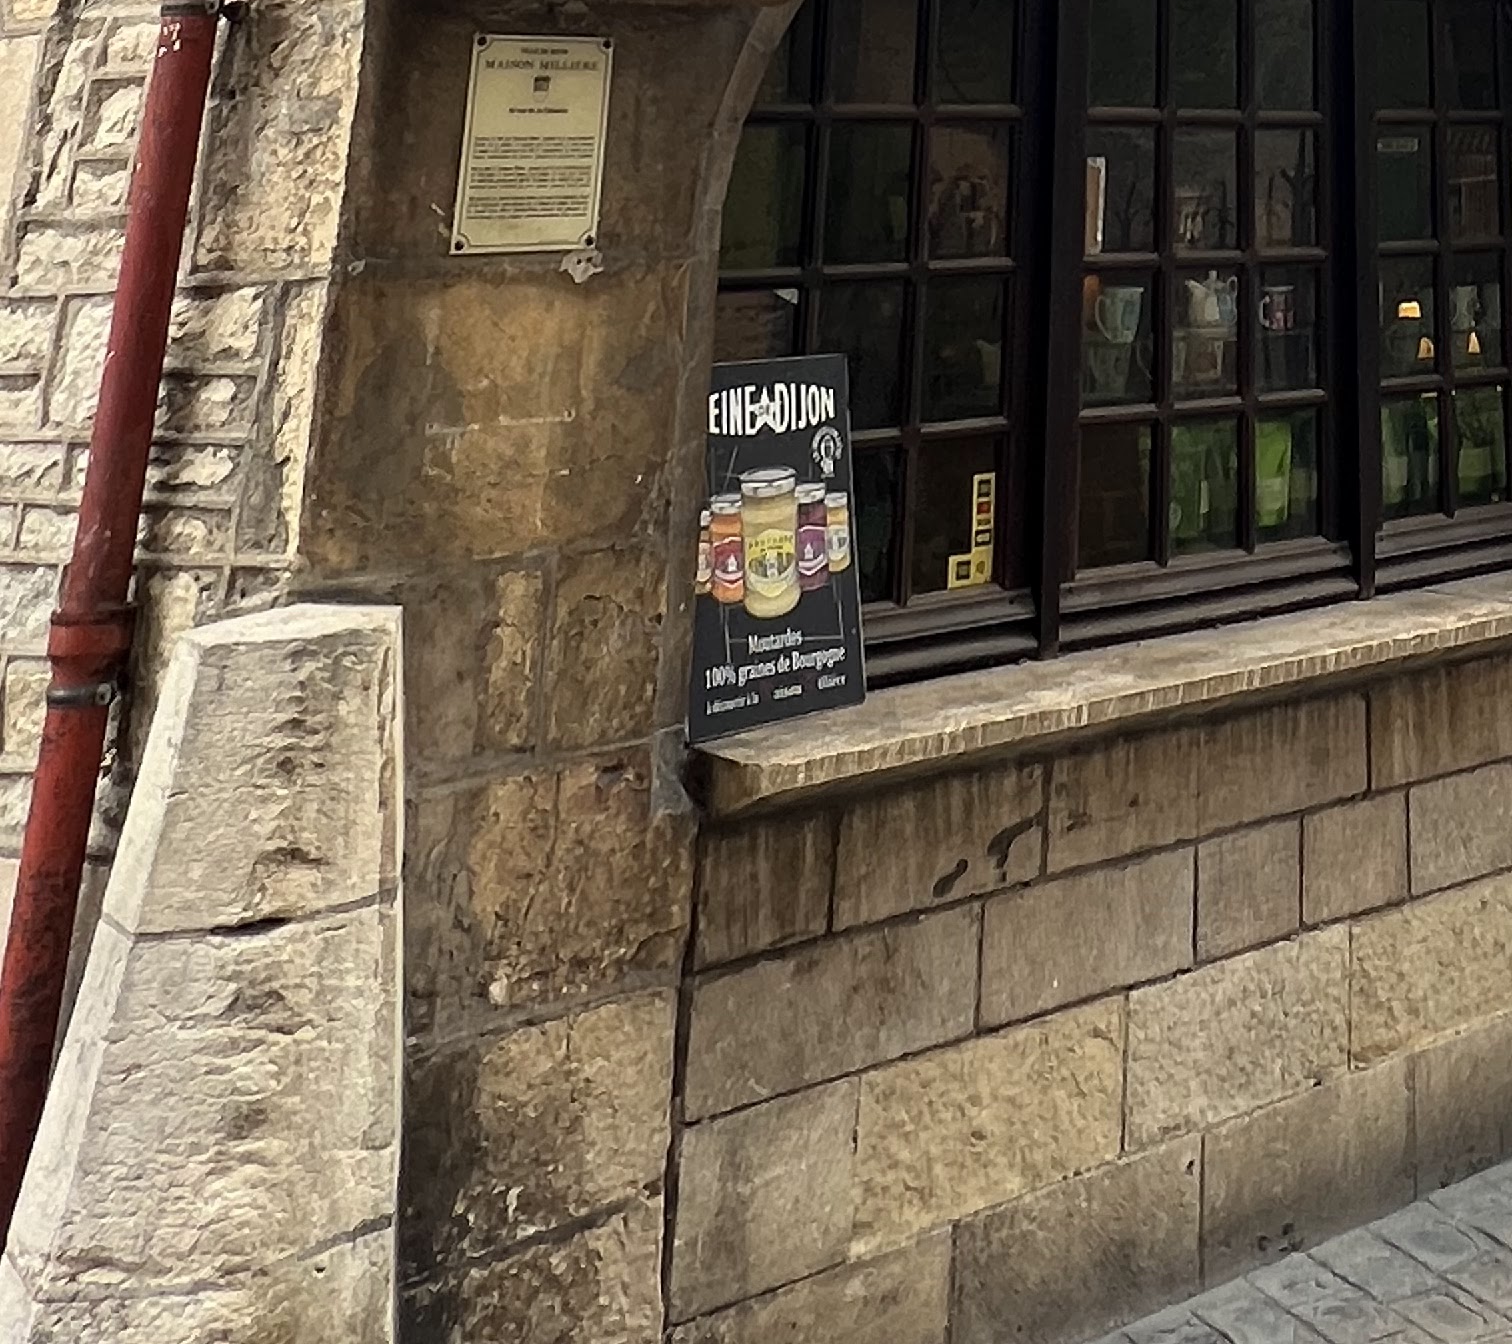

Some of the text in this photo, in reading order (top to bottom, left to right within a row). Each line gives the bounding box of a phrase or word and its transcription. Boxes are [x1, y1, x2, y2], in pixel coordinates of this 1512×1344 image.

[709, 384, 757, 435] EINE
[774, 382, 835, 433] DIJON
[749, 627, 802, 654] Moutardes
[705, 647, 846, 689] 100% graines de Bourgogne
